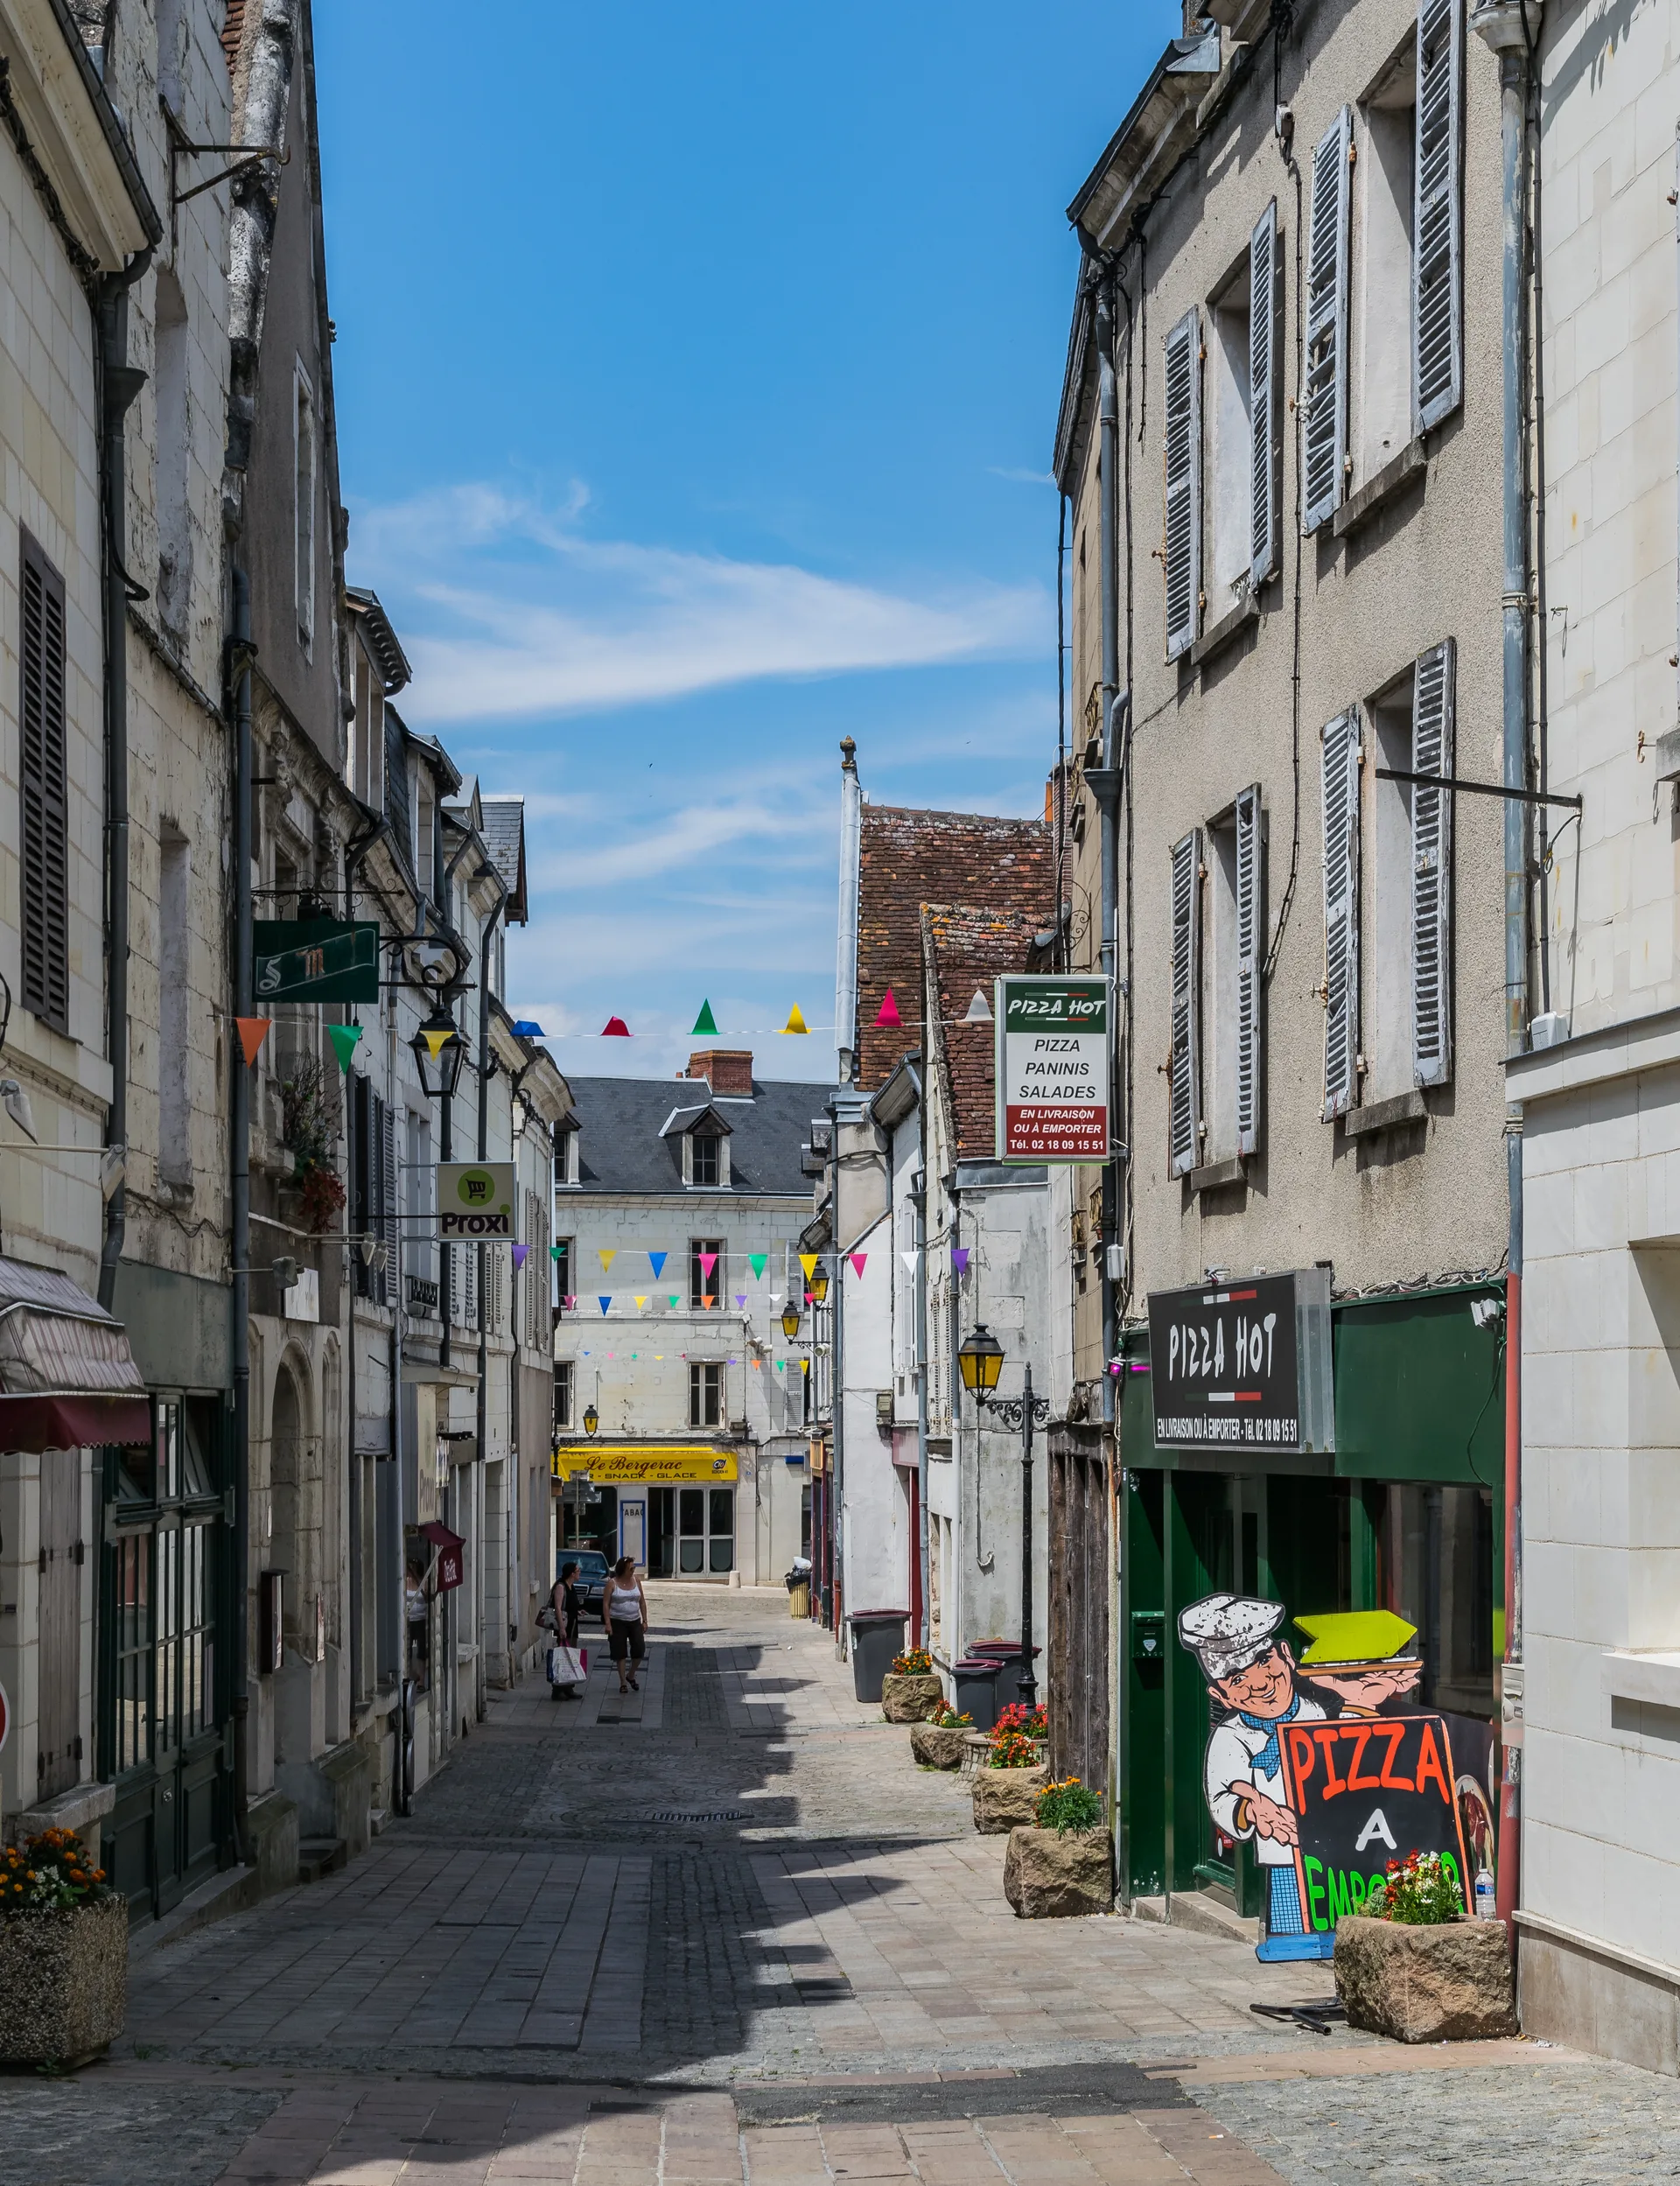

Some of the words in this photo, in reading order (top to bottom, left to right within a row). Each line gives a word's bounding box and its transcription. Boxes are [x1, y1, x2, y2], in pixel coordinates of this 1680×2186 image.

[1008, 999, 1062, 1014] PIZZA
[1069, 1000, 1106, 1015] HOT
[1034, 1040, 1080, 1052] PIZZA
[1026, 1062, 1089, 1075] PANINIS
[1019, 1085, 1096, 1099] SALADES
[1020, 1110, 1035, 1118] EN
[1038, 1110, 1095, 1119] LIVRAISON
[1013, 1124, 1030, 1132] OU
[1032, 1122, 1040, 1132] À
[1042, 1125, 1102, 1133] EMPORTER
[1010, 1139, 1029, 1149] Tél.
[1032, 1140, 1044, 1149] 02
[1047, 1140, 1059, 1149] 18
[1062, 1140, 1074, 1149] 09
[1078, 1140, 1088, 1149] 15
[1092, 1140, 1103, 1149] 51
[442, 1204, 510, 1234] Proxi
[1169, 1317, 1224, 1381] PIZZA
[1236, 1313, 1277, 1379] HOT
[1157, 1419, 1165, 1438] EN
[1166, 1419, 1193, 1438] LIVRAISON
[1194, 1419, 1202, 1439] OU
[1203, 1413, 1208, 1439] À
[1208, 1419, 1240, 1440] EMPORTER
[1244, 1419, 1255, 1440] Tél.
[1256, 1419, 1264, 1440] 02
[1264, 1419, 1271, 1440] 18
[1273, 1419, 1280, 1441] 09
[1282, 1419, 1288, 1441] 15
[1290, 1419, 1298, 1441] 51
[584, 1456, 606, 1470] Le
[609, 1456, 682, 1477] Bergerac
[1289, 1722, 1451, 1815] PIZZA
[1355, 1808, 1397, 1852] A
